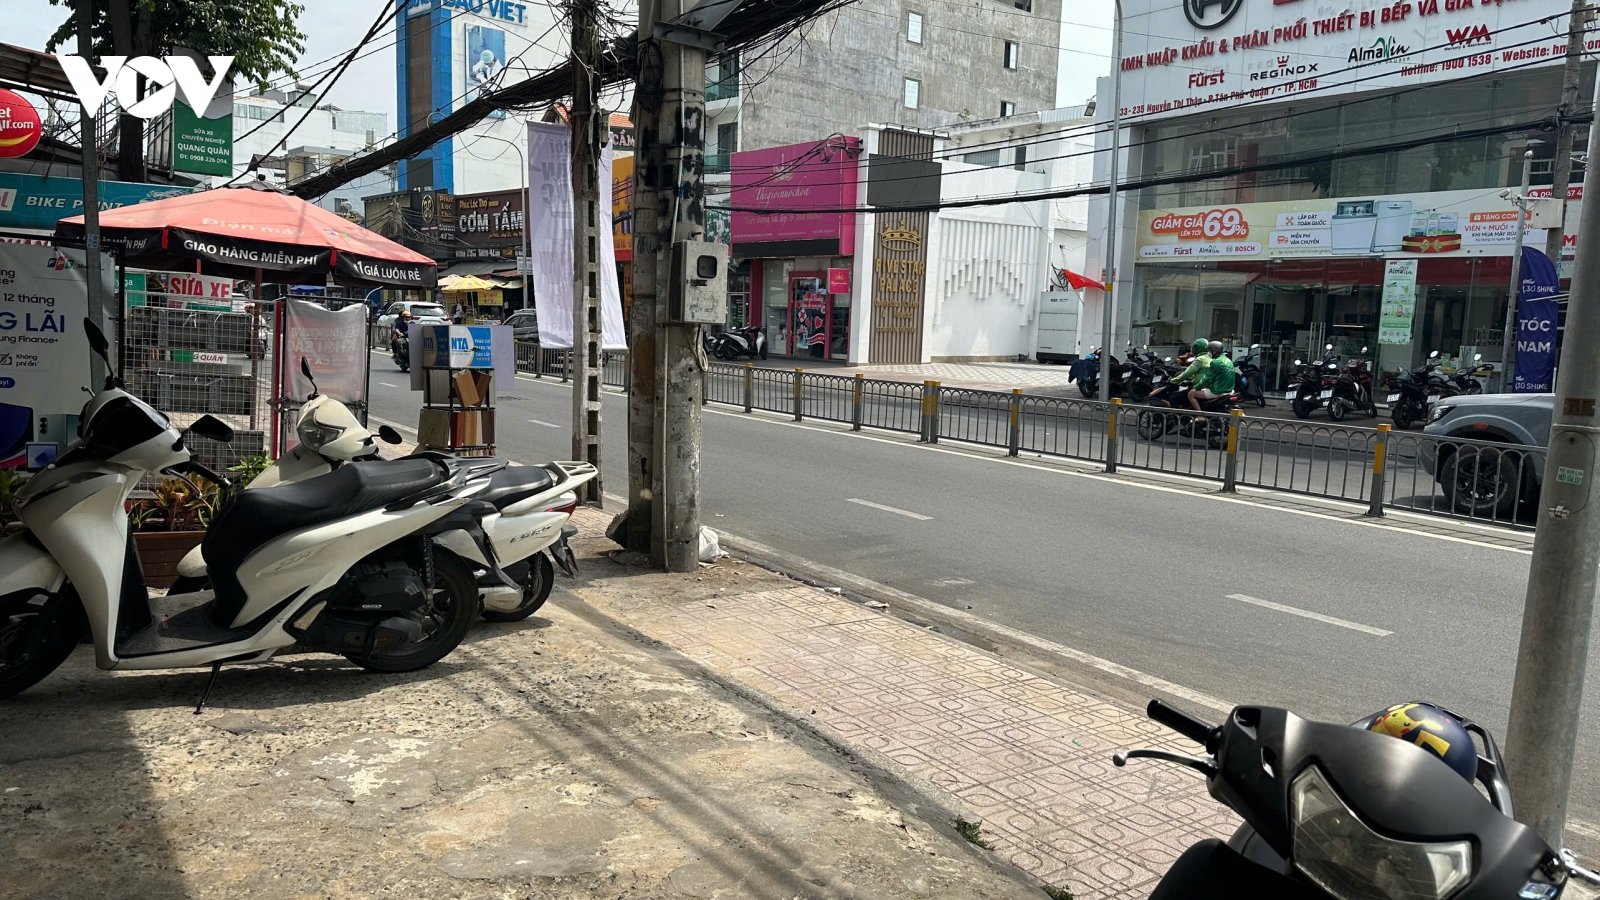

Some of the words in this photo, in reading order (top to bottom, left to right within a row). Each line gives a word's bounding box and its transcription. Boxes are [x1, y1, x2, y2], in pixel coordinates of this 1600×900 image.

[1147, 46, 1178, 67] NHẬP
[1181, 36, 1214, 60] KHẨU
[1218, 38, 1228, 54] &
[1233, 30, 1269, 51] PHÂN
[1273, 17, 1307, 43] PHỐI
[1312, 9, 1355, 36] THIẾT
[1359, 12, 1376, 29] BỊ
[1380, 0, 1412, 24] BẾP
[1418, 0, 1439, 17] VÀ
[1348, 35, 1410, 64] AlmaWin
[1400, 63, 1439, 77] Hotline:
[1441, 58, 1464, 71] 1900
[1467, 54, 1491, 67] 1538
[1502, 46, 1550, 62] Website:
[1188, 69, 1225, 89] Fürst
[1250, 63, 1318, 82] REGINOX
[1147, 98, 1172, 115] Nguyễn
[1298, 79, 1318, 91] HCM
[181, 133, 204, 142] CHUYÊN
[194, 127, 206, 135] SỬA
[177, 142, 206, 153] QUANG
[207, 146, 230, 156] QUÂN
[190, 154, 204, 162] 0908
[26, 196, 66, 208] BIKE
[72, 199, 124, 211] PINT
[459, 210, 489, 232] CƠM
[492, 201, 523, 231] TẤM
[1153, 214, 1182, 230] GIẢM
[1184, 214, 1203, 228] GIÁ
[1203, 210, 1247, 237] 69%
[1482, 214, 1501, 222] TẶNG
[1501, 211, 1528, 220] COMO
[1464, 224, 1481, 232] VIÊN
[132, 238, 148, 248] PHÍ
[183, 239, 217, 255] GIAO
[219, 246, 258, 262] HÀNG
[261, 250, 294, 266] MIỄN
[296, 254, 319, 266] PHÍ
[1173, 247, 1192, 255] Fürst
[47, 255, 74, 270] FPT
[875, 258, 899, 274] FIVE
[901, 260, 925, 275] STAR
[364, 263, 379, 276] GIÁ
[381, 266, 407, 280] LUÔN
[407, 267, 421, 281] RẺ
[170, 273, 203, 297] SỬA
[879, 278, 918, 293] PALACE
[1536, 285, 1556, 293] SHINE
[3, 293, 15, 302] 12
[18, 294, 55, 307] tháng
[0, 312, 18, 331] G
[25, 310, 65, 333] LÃI
[1519, 317, 1551, 332] TÓC
[18, 335, 59, 344] Finance+
[451, 337, 469, 350] NTA
[1517, 340, 1551, 353] NAM
[1526, 382, 1548, 391] SHINE
